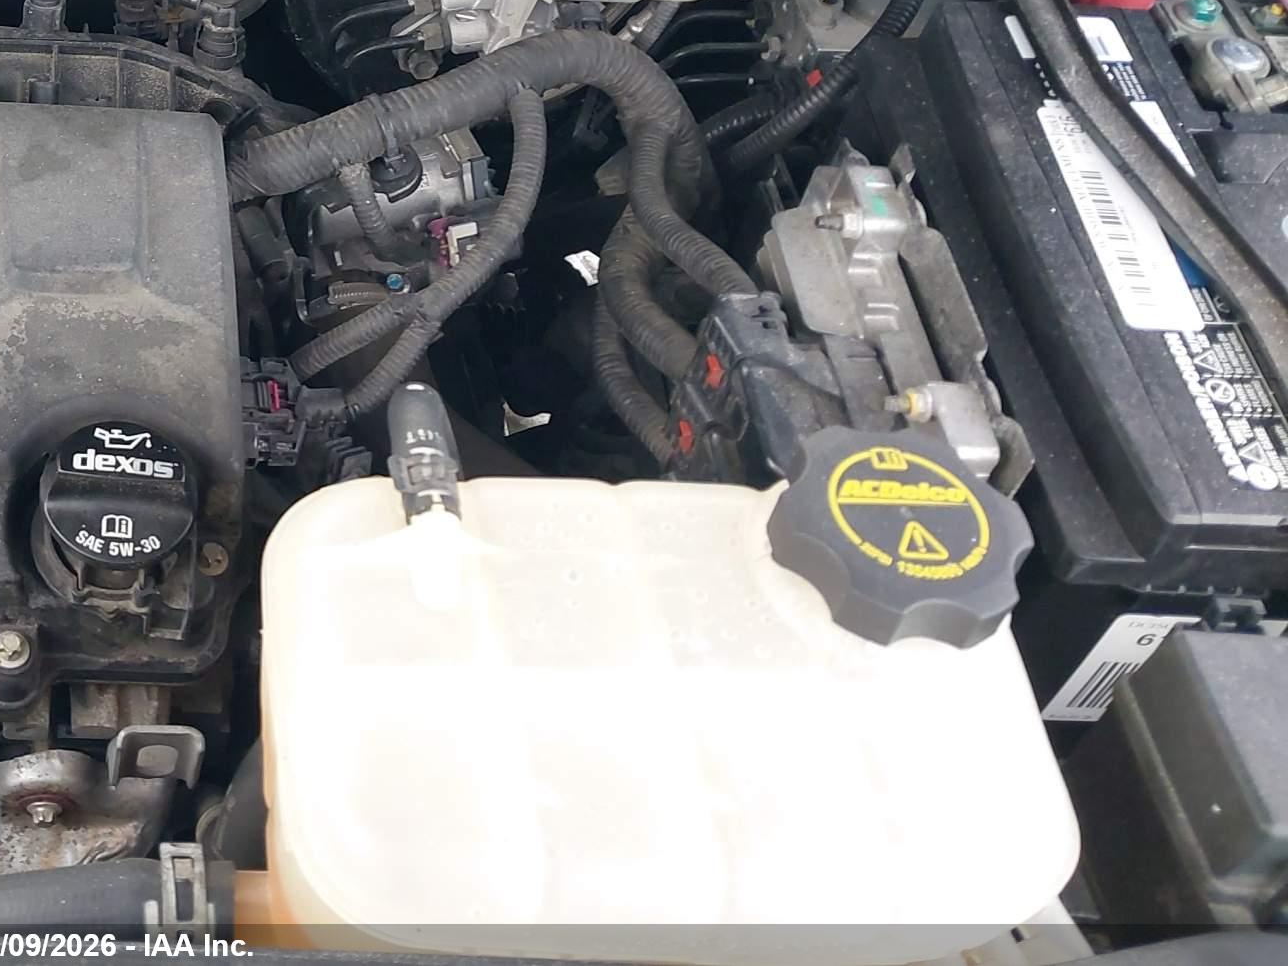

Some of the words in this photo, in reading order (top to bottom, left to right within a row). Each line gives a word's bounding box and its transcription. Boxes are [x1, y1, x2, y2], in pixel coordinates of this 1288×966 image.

[73, 449, 175, 479] dexos
[840, 480, 967, 503] ACDelco
[76, 530, 103, 554] SAE
[109, 535, 161, 557] 5W-30
